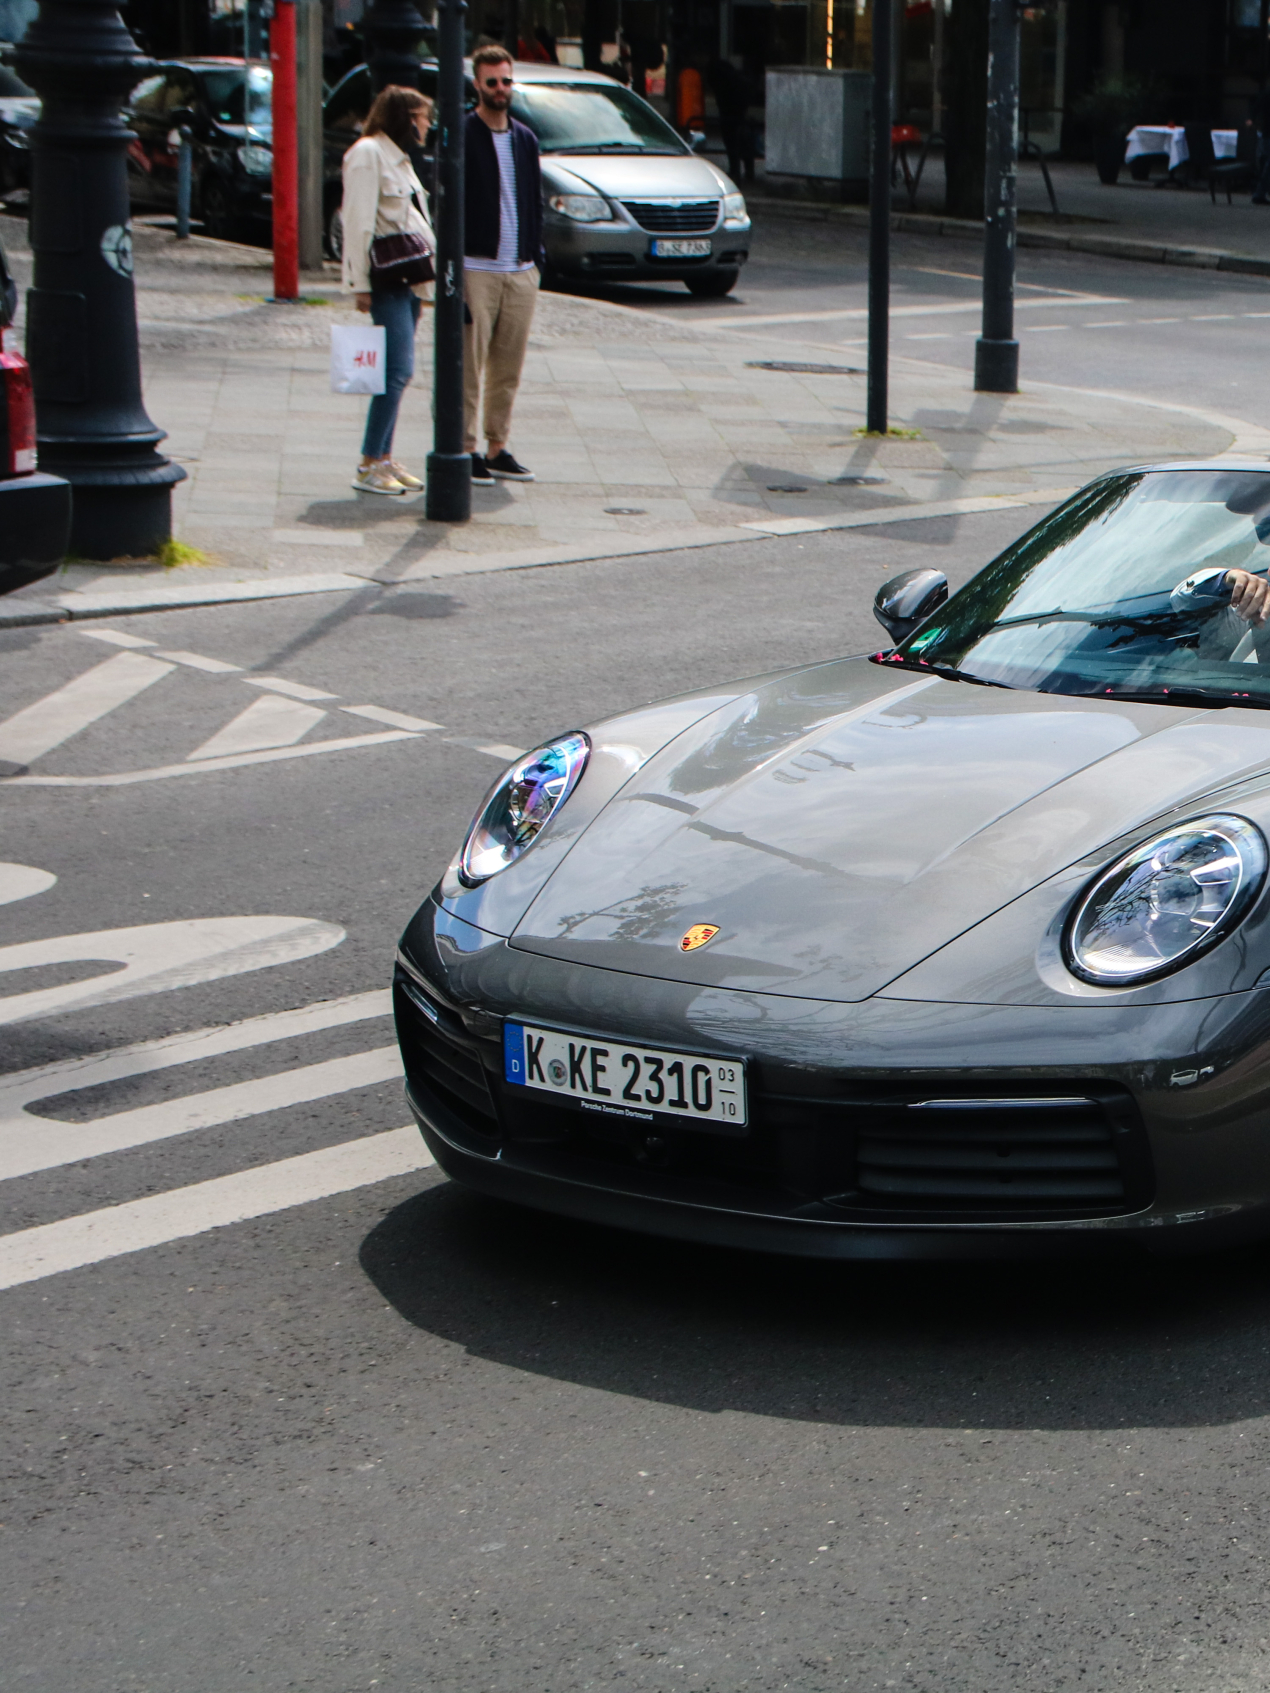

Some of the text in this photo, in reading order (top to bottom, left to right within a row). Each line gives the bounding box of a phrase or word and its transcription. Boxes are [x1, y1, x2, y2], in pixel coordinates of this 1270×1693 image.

[511, 1059, 520, 1073] D
[526, 1033, 713, 1111] K KE 2310
[718, 1066, 735, 1082] 03
[581, 1100, 654, 1120] Porsche Zentrum Dortmund
[721, 1101, 736, 1116] 10
